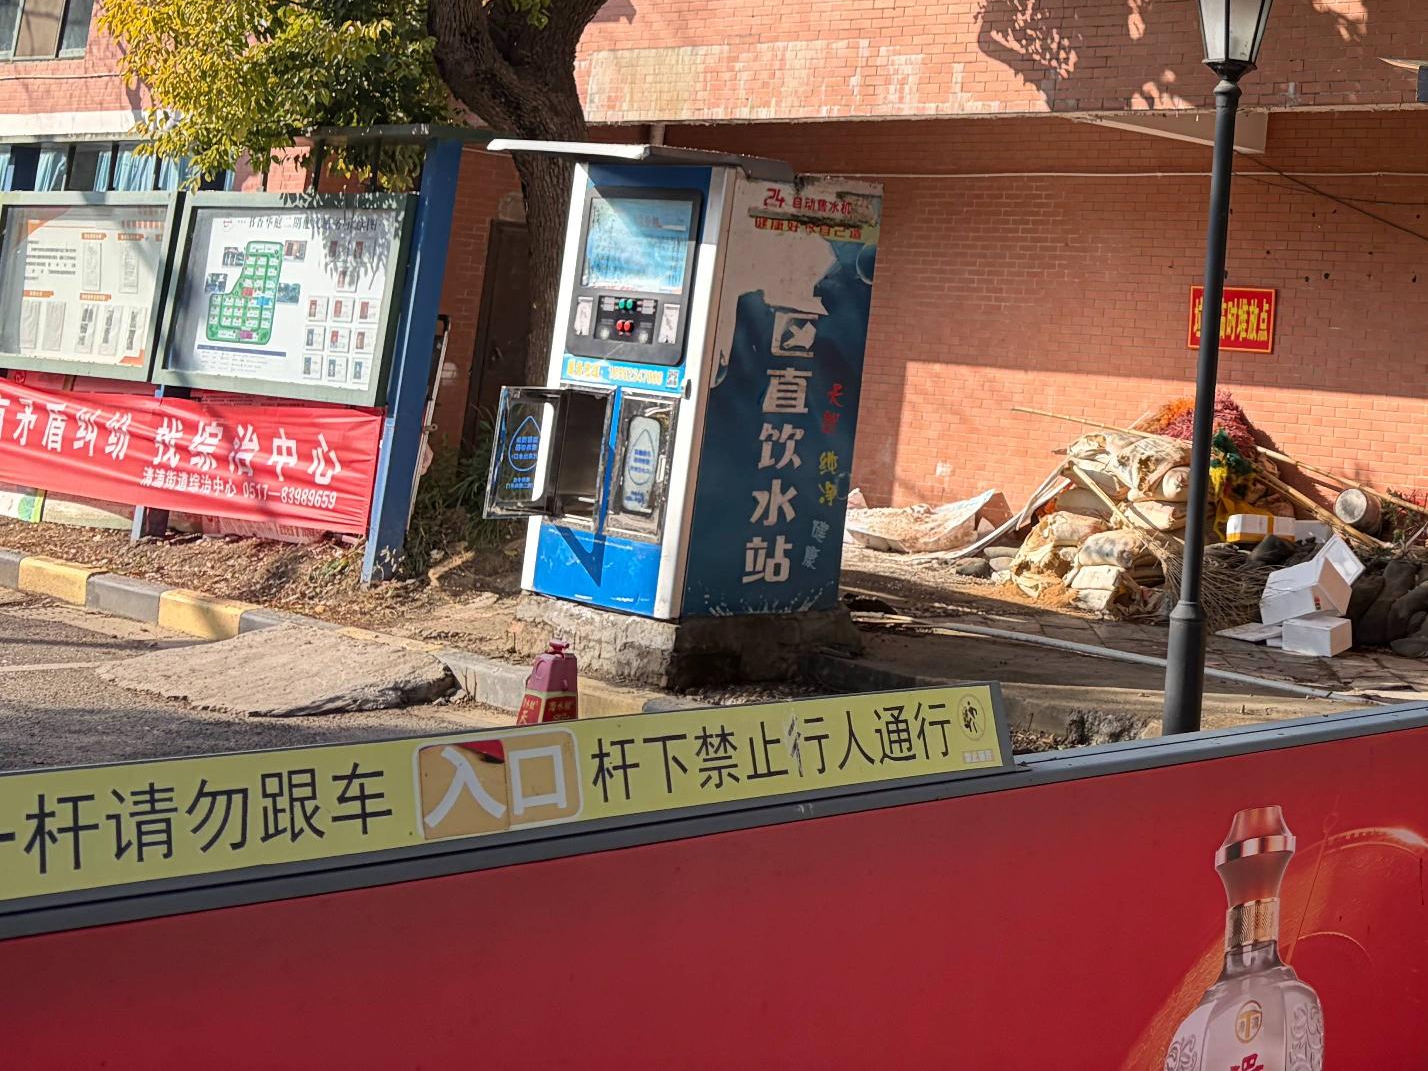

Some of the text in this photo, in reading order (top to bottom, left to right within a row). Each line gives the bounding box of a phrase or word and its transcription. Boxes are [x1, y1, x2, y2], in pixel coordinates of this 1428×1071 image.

[763, 187, 852, 215] 24 自动售水机
[1194, 296, 1269, 341] 垃临时堆放点
[153, 417, 342, 485] 找综治中心
[424, 744, 568, 828] 入口
[592, 700, 952, 804] 杆下禁止行人通行
[0, 762, 393, 875] 杆请勿跟车
